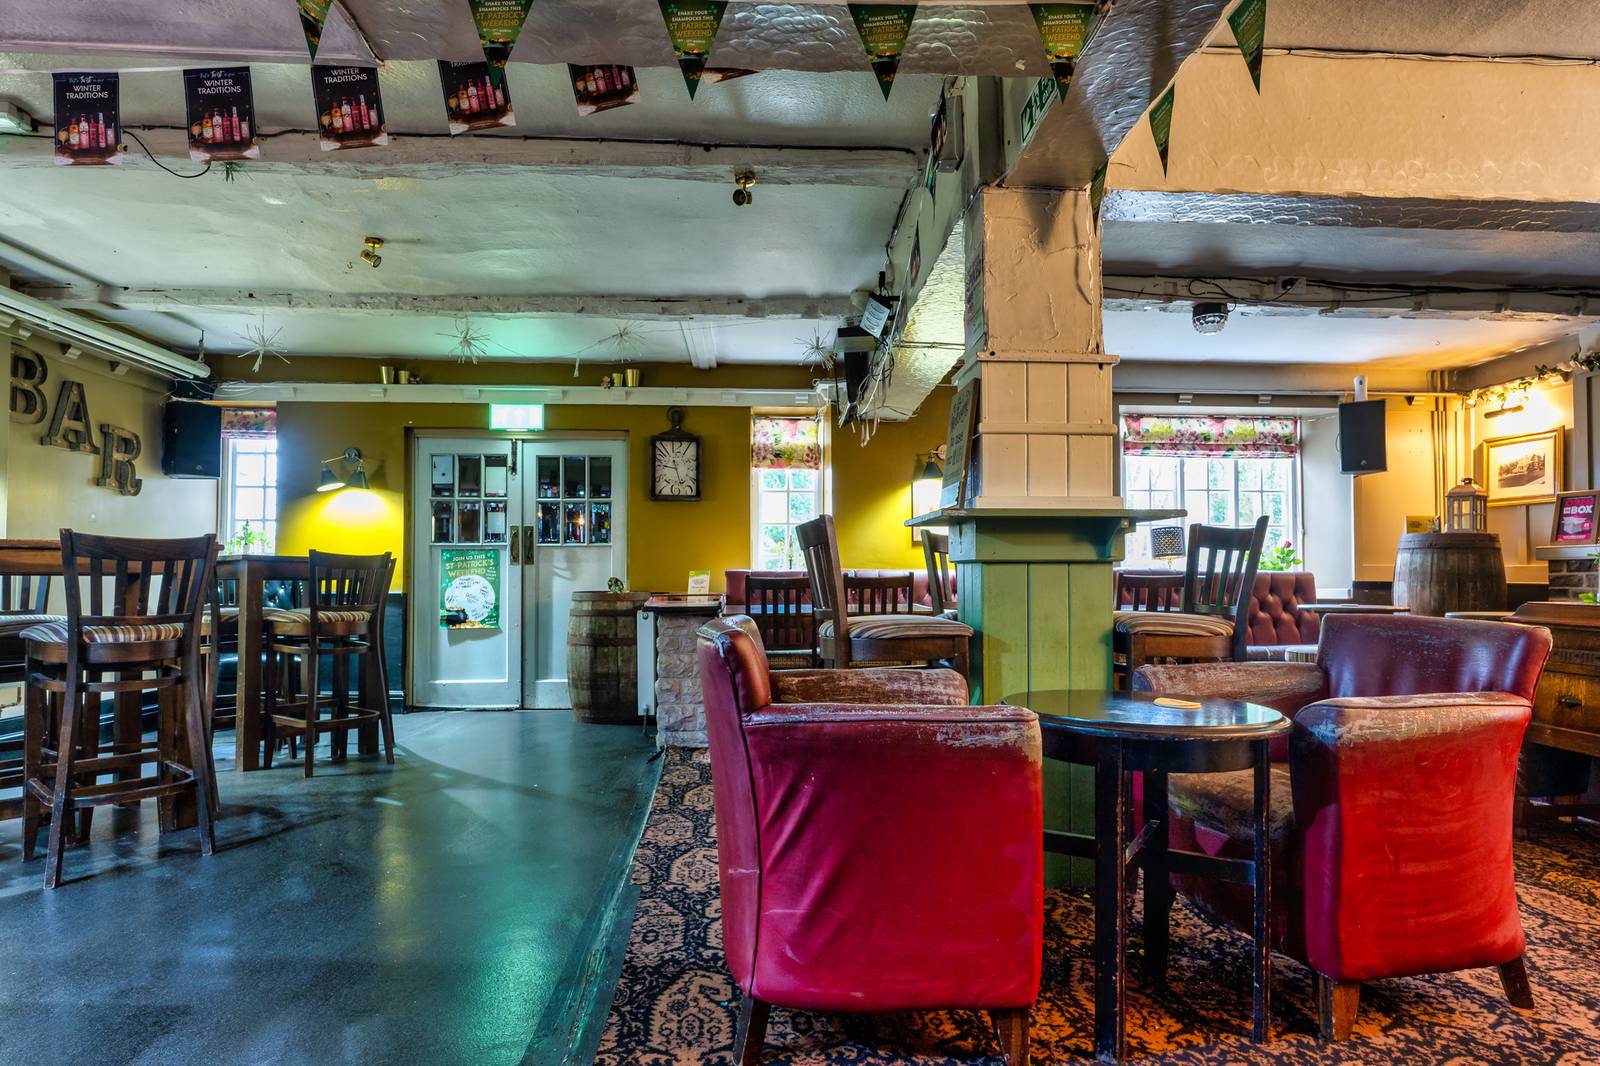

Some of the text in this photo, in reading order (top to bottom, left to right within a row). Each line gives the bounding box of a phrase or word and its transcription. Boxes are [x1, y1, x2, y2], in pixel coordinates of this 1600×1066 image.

[331, 68, 360, 76] WINTER
[324, 74, 368, 84] TRADITIONS
[198, 86, 242, 94] TRADITIONS
[65, 92, 109, 100] TRADITIONS
[9, 342, 143, 497] BAR
[1570, 505, 1593, 514] BOX
[458, 559, 494, 569] PATRICK'S
[448, 568, 486, 577] WEEKEND
